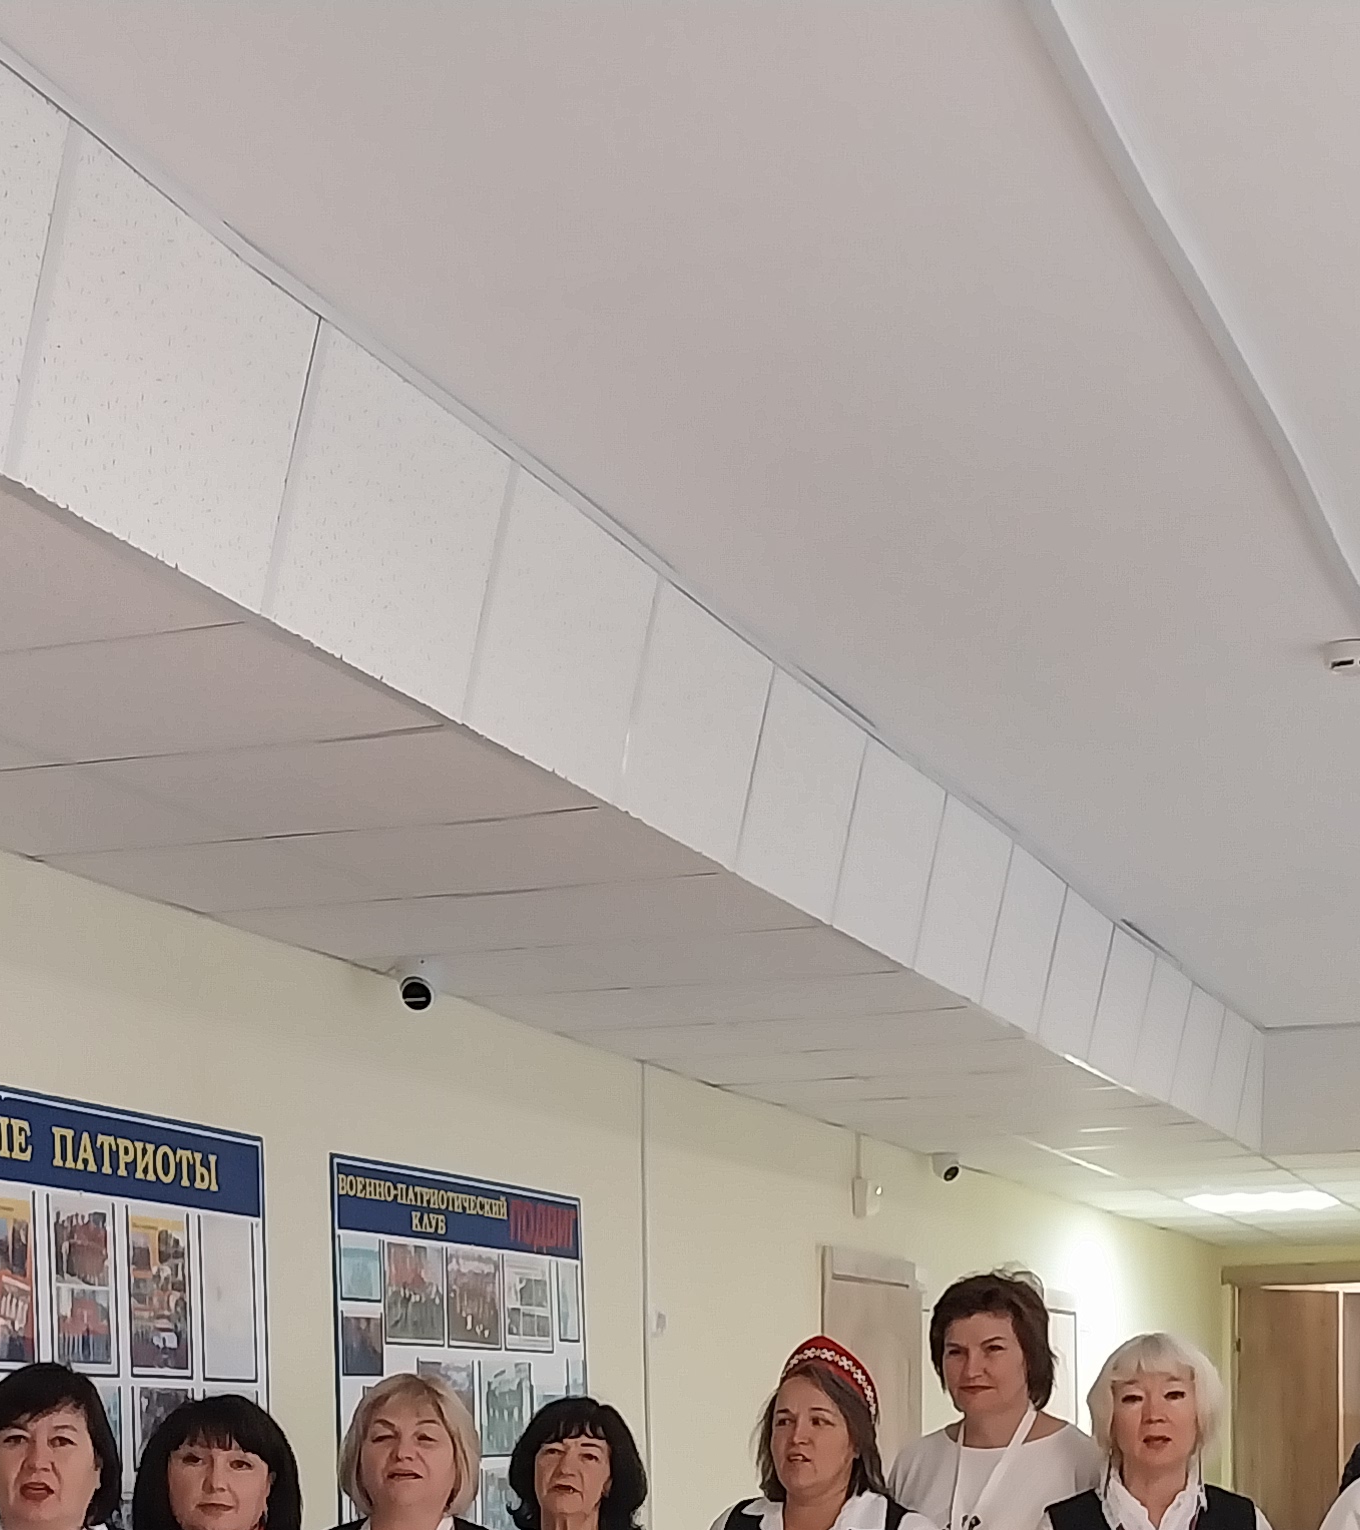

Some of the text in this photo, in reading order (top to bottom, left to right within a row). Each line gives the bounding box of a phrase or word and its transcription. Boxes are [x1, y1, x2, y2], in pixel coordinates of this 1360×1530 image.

[51, 1126, 219, 1192] ПАТРИОТЫ
[338, 1173, 508, 1220] ВОЕННО-ПАТРИОТИЧЕСКИЙ
[411, 1211, 447, 1235] КЛУБ
